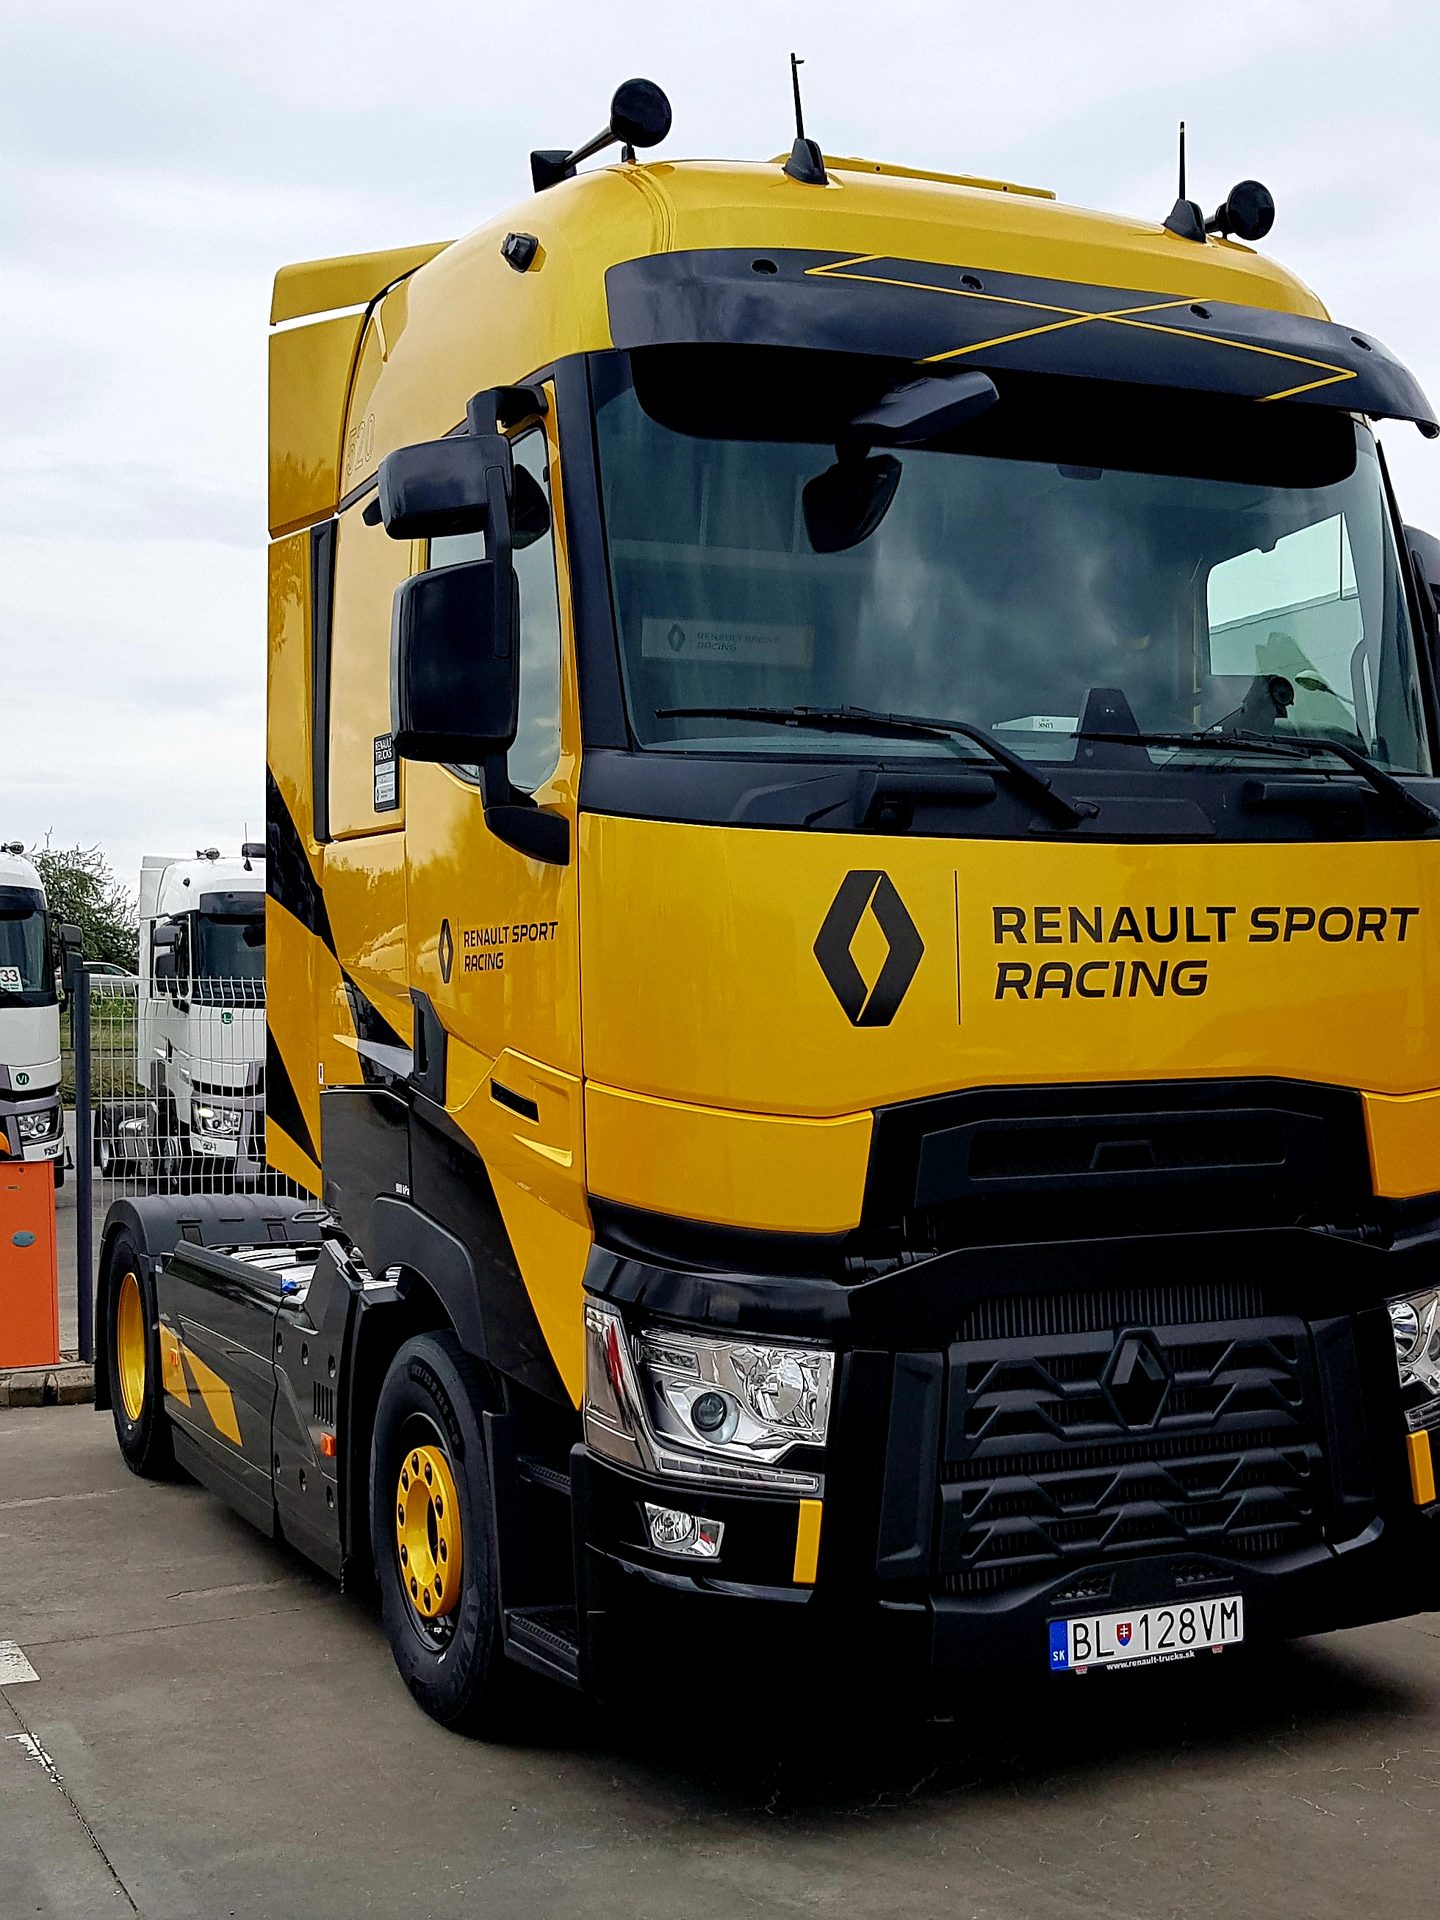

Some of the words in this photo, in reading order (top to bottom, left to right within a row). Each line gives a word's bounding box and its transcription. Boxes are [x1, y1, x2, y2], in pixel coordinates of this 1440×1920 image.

[697, 632, 741, 643] RENAULT
[697, 642, 737, 652] RACING
[463, 926, 509, 948] RENAULT
[511, 921, 558, 943] SPORT
[992, 906, 1236, 944] RENAULT
[1248, 906, 1419, 943] SPORT
[464, 952, 504, 972] RACING
[0, 969, 19, 982] 33
[995, 959, 1208, 999] RACING
[18, 1074, 29, 1084] VI
[1072, 1620, 1115, 1661] BL
[1138, 1600, 1239, 1651] 128VM
[1052, 1651, 1066, 1662] SK
[1106, 1650, 1196, 1671] www.renault-trucks.sk
